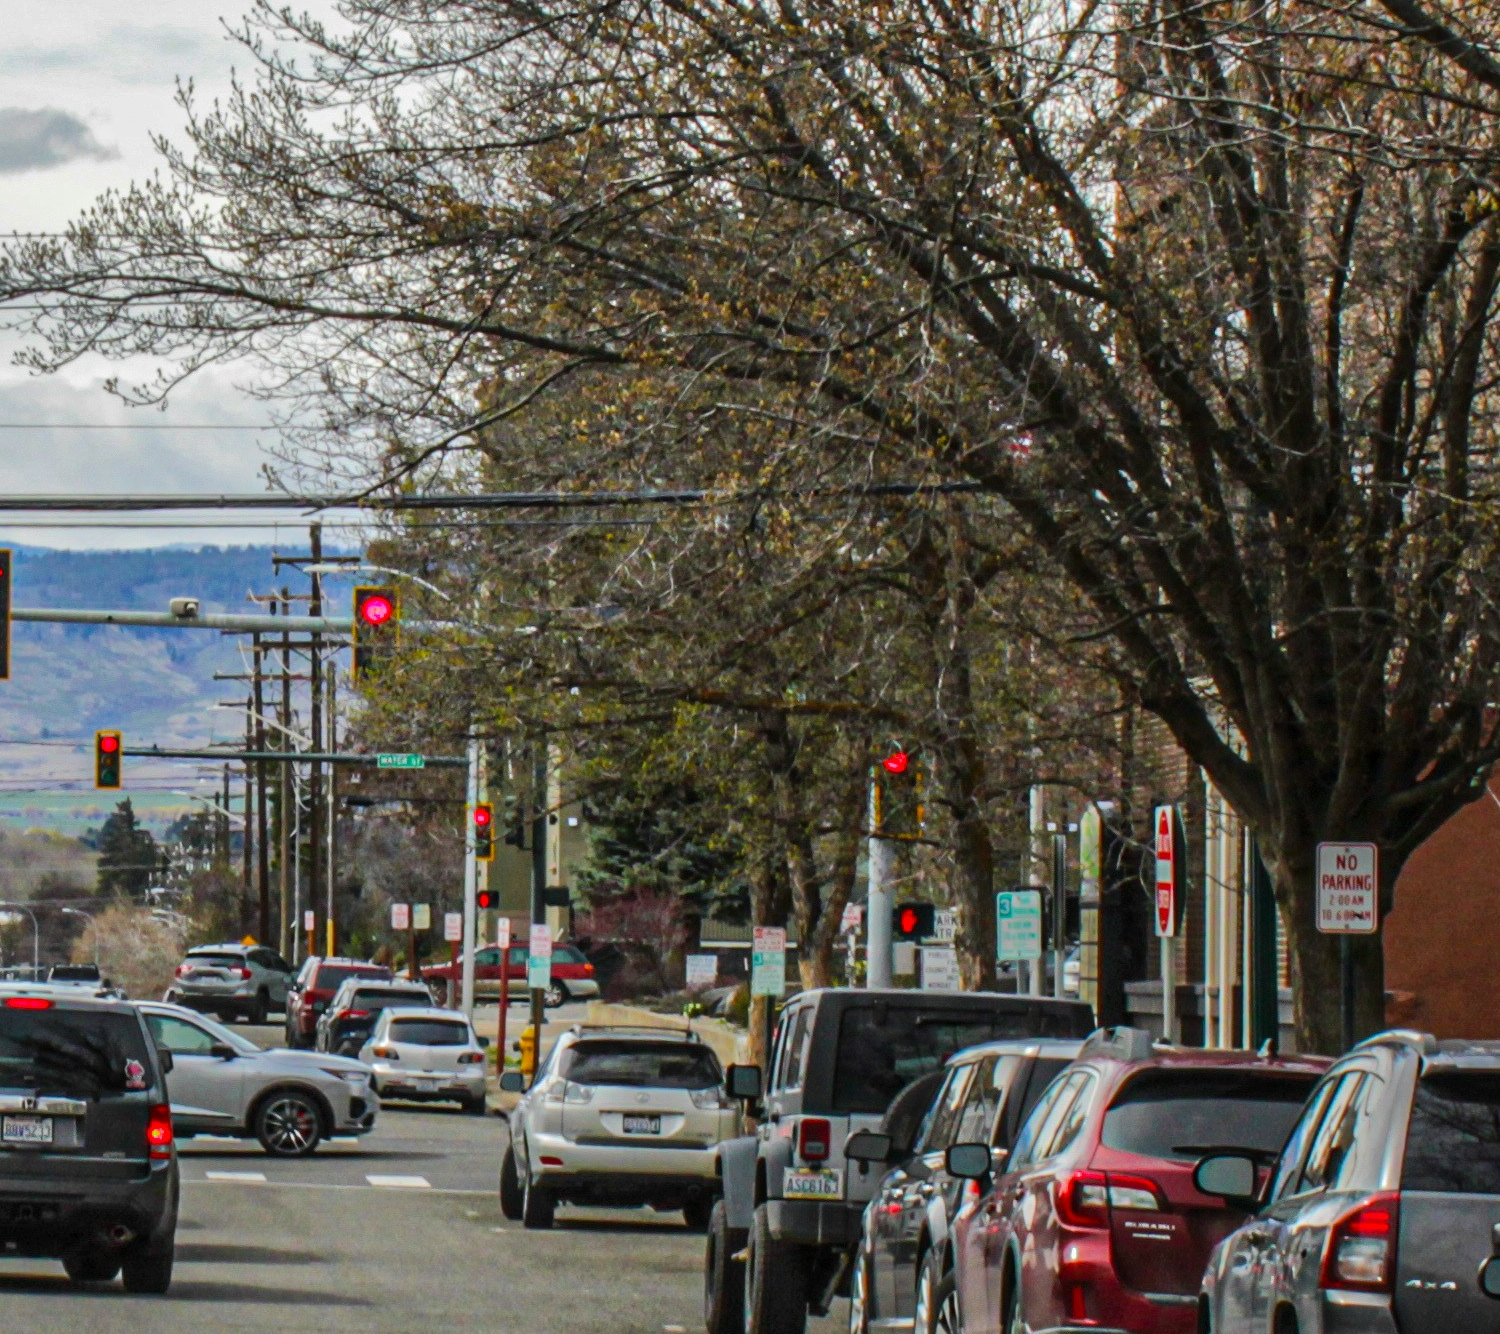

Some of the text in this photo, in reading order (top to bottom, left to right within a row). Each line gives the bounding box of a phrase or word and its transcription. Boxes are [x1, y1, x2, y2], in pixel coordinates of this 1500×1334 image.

[1336, 854, 1357, 871] NO
[1322, 874, 1372, 891] PARKING
[1352, 895, 1364, 905] AM
[1322, 909, 1332, 920] TO
